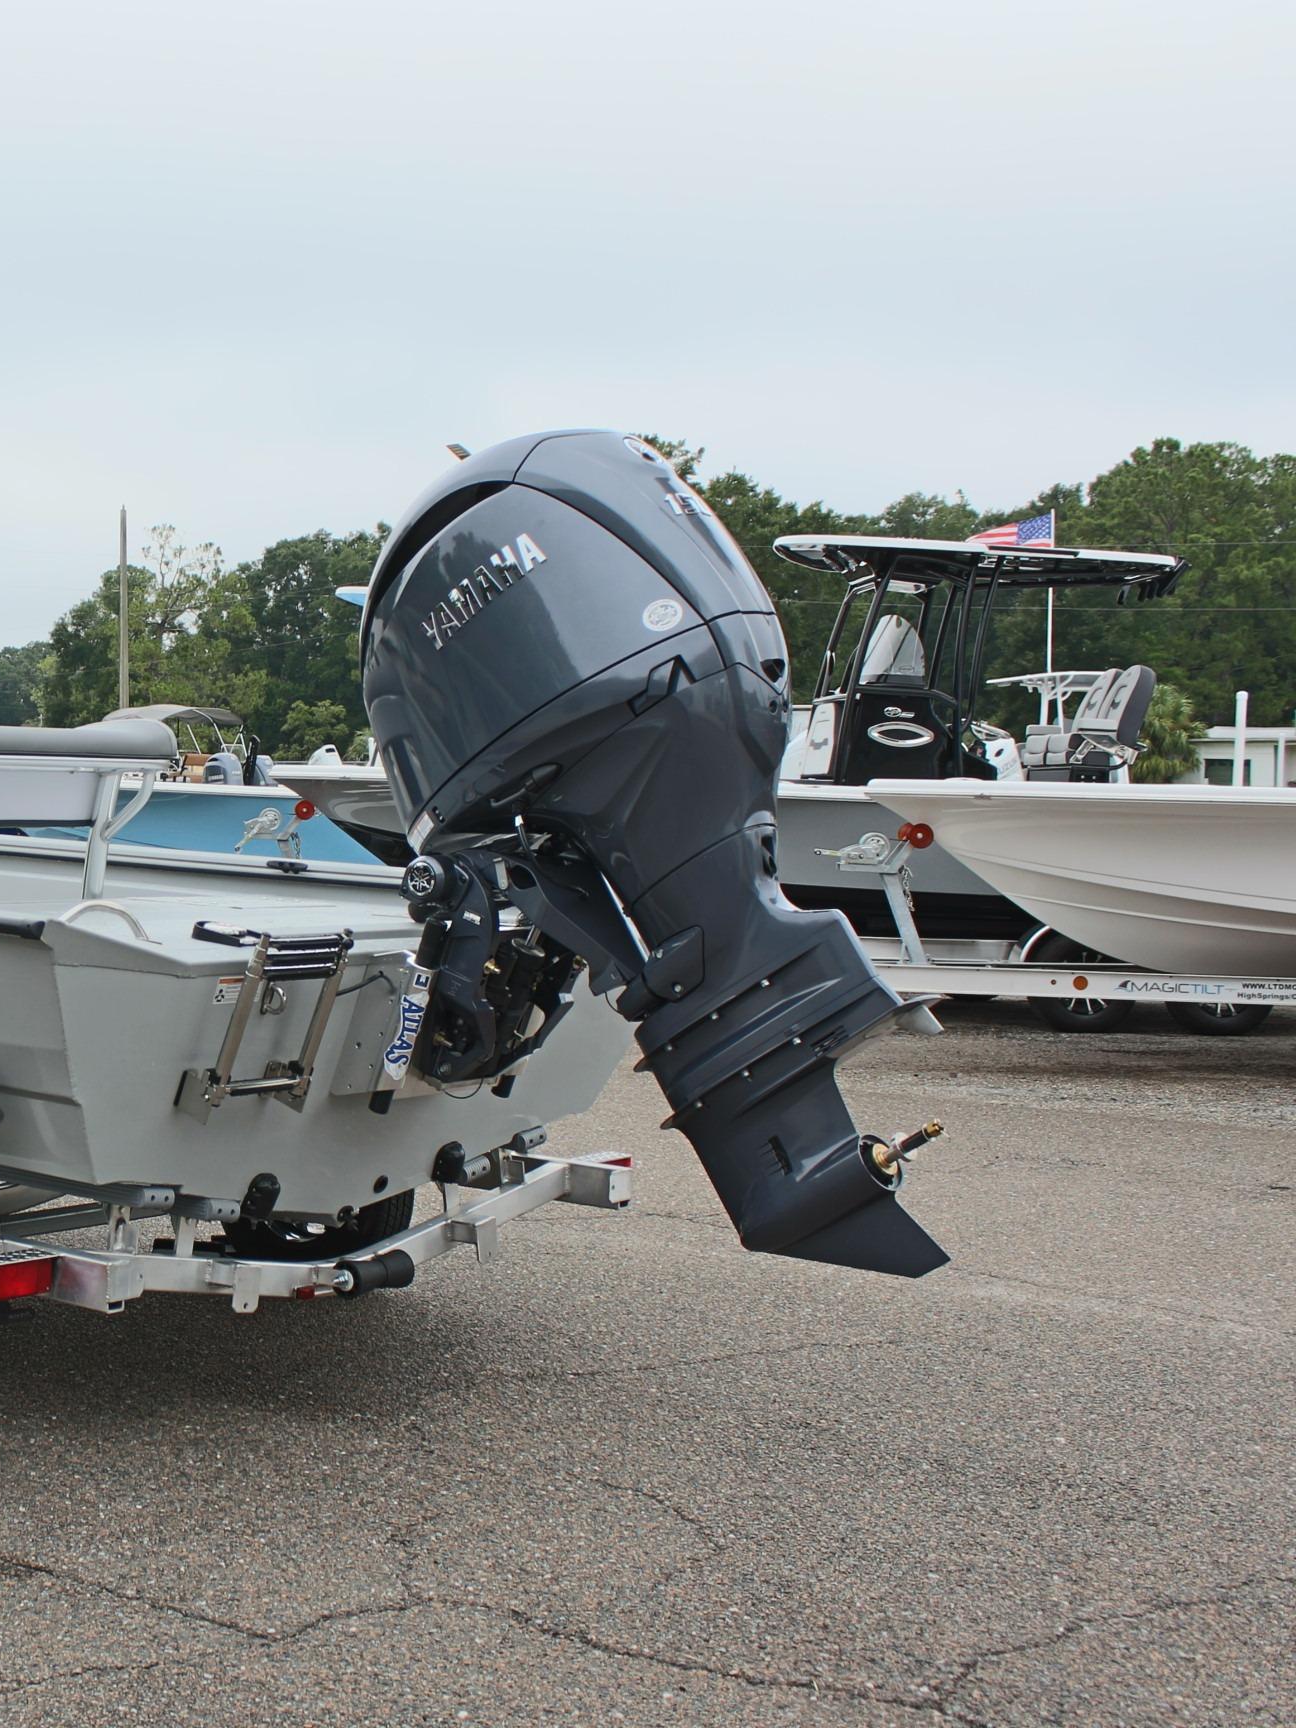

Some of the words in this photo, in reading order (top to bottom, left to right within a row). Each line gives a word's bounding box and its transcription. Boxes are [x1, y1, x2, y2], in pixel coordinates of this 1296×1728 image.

[421, 533, 548, 650] YAMAHA
[1130, 982, 1224, 994] MAGICTILT
[384, 995, 426, 1066] ATLAS
